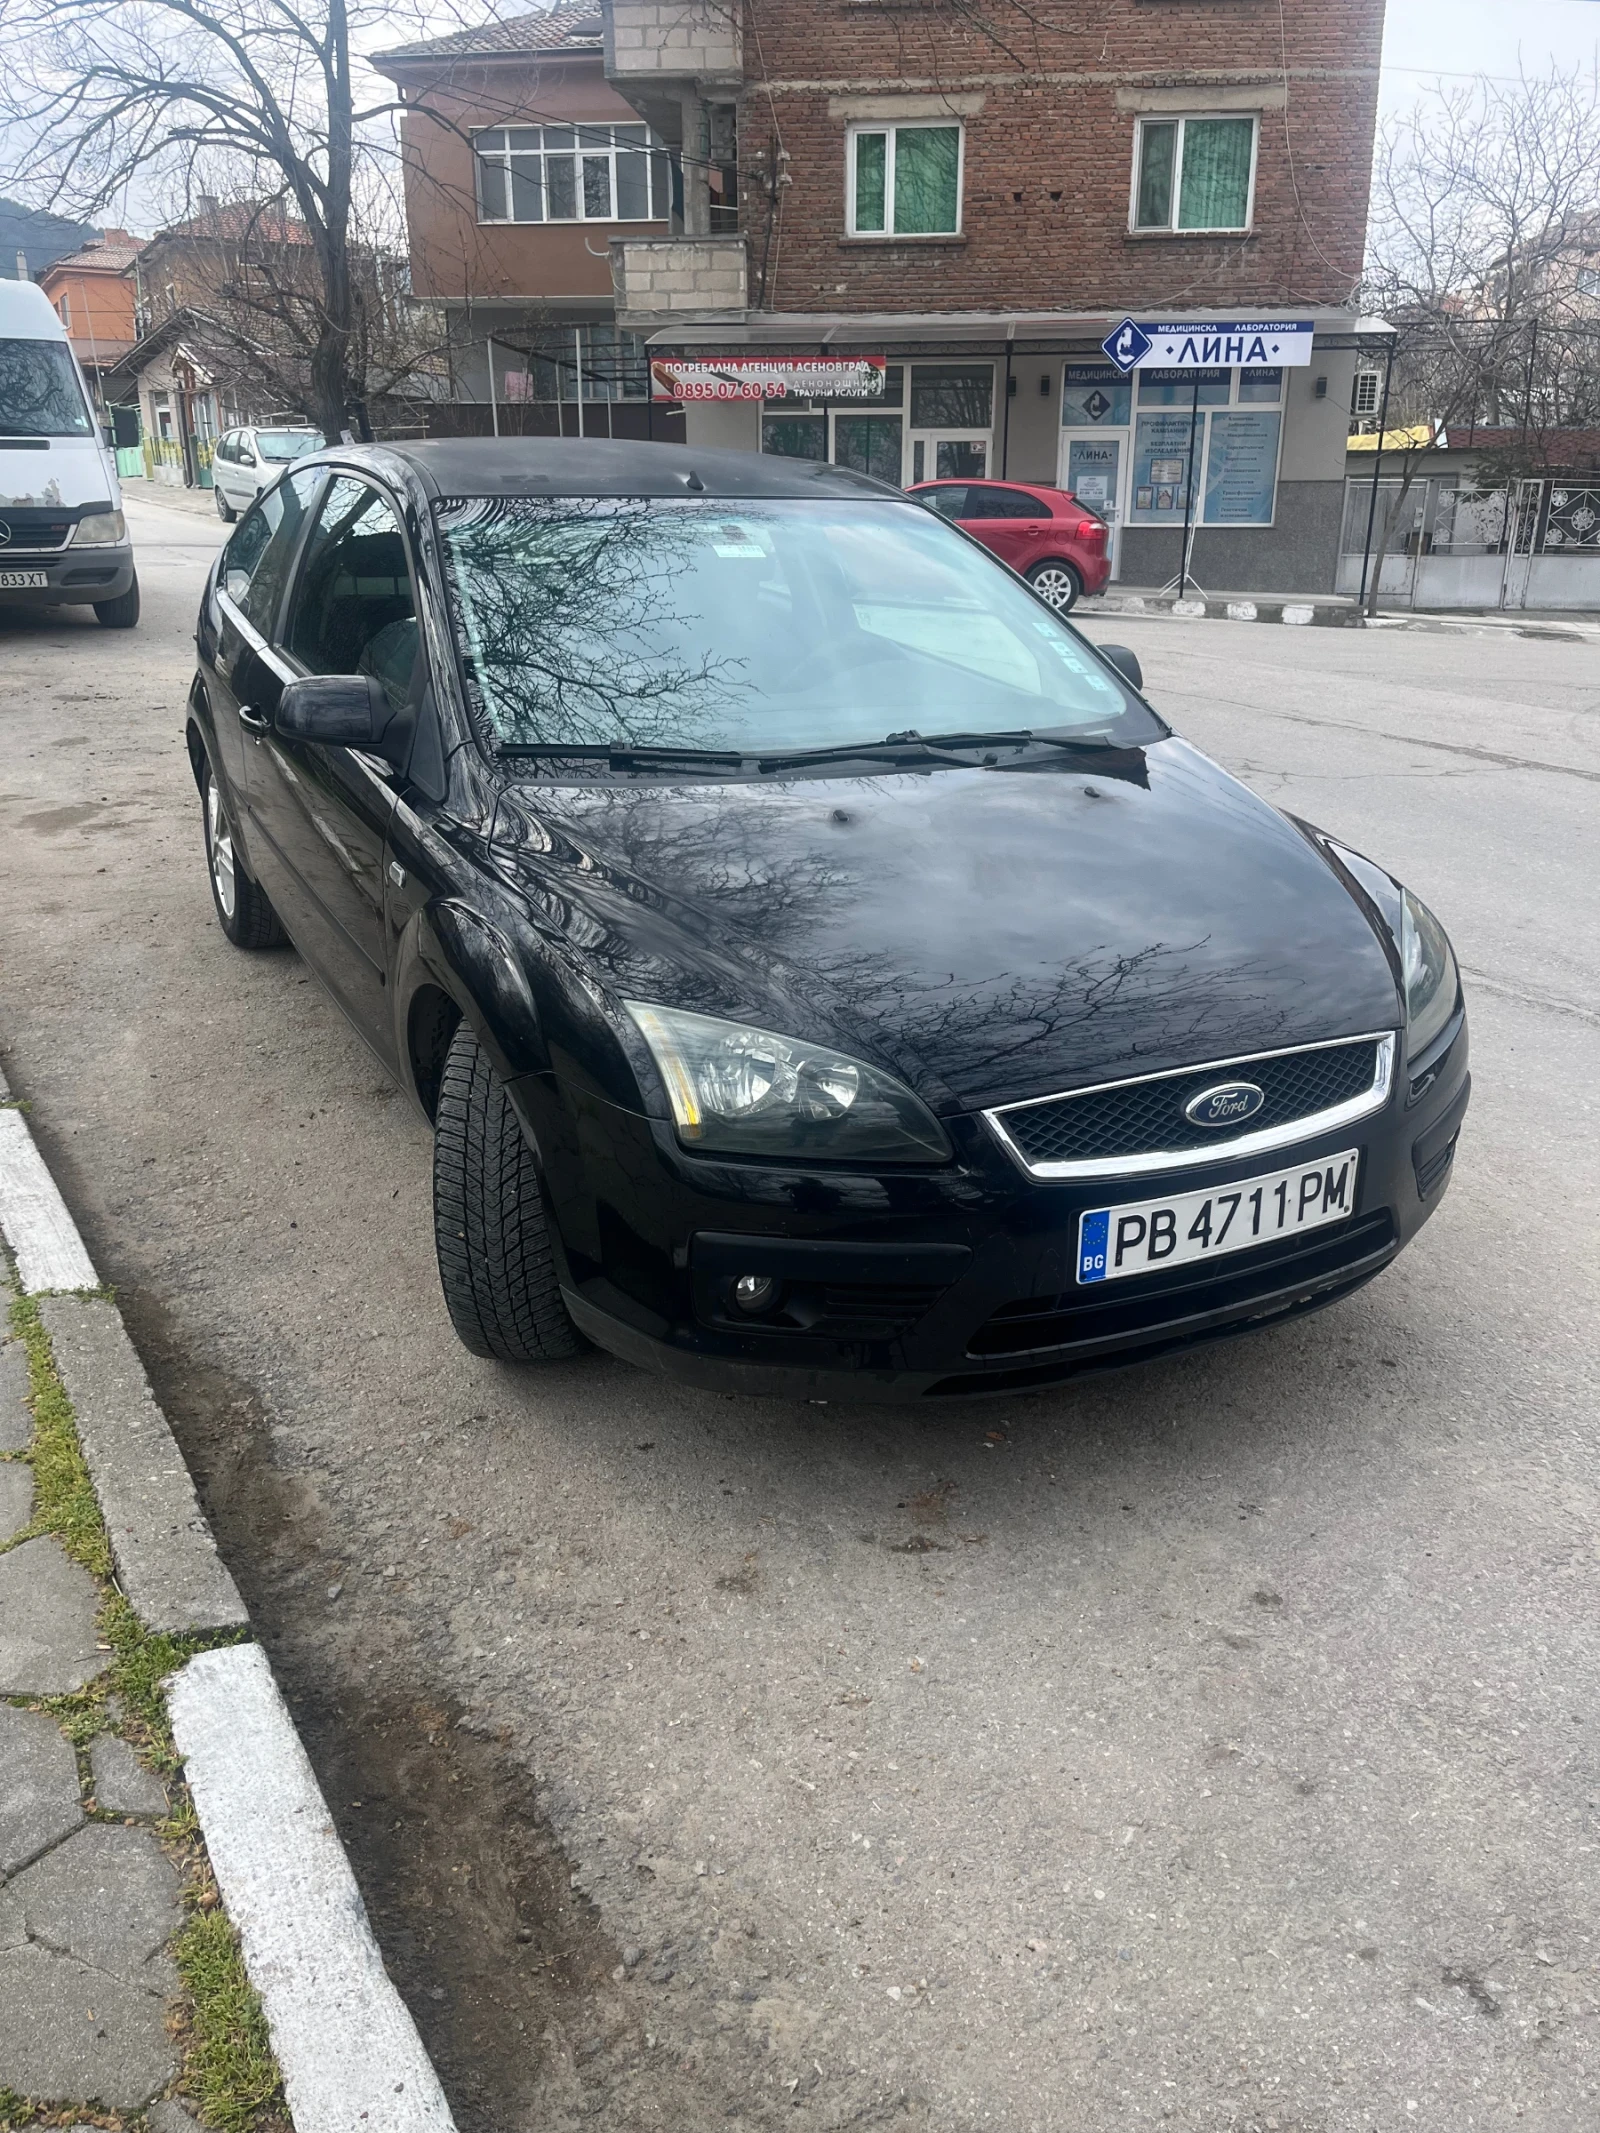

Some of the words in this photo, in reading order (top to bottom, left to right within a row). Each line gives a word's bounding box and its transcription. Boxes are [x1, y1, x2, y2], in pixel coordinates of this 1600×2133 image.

[1157, 324, 1218, 334] МЕДИЦИНСКА
[1234, 323, 1298, 332] ЛАБОРАТОРИЯ
[1177, 336, 1268, 363] ЛИНА
[665, 362, 738, 373] ПОГРЕБАЛНА
[741, 362, 793, 375] АГЕНЦИЯ
[796, 360, 871, 373] АСЕНОВГРАД
[1249, 369, 1276, 377] ЛИНА
[675, 382, 713, 398] 0895
[718, 382, 738, 398] 07
[742, 381, 762, 398] 60
[766, 381, 786, 398] 54
[793, 379, 869, 389] ДЕНОНОЩНИ
[794, 388, 833, 397] ТРАУРНИ
[835, 388, 869, 397] УСЛУГИ
[1078, 450, 1108, 460] ЛИНА
[1, 573, 25, 586] 833
[26, 573, 44, 586] XT
[1208, 1092, 1249, 1118] Ford
[1114, 1208, 1177, 1267] PB
[1187, 1180, 1288, 1249] 4711
[1297, 1161, 1350, 1222] PM
[1083, 1254, 1104, 1272] BG
